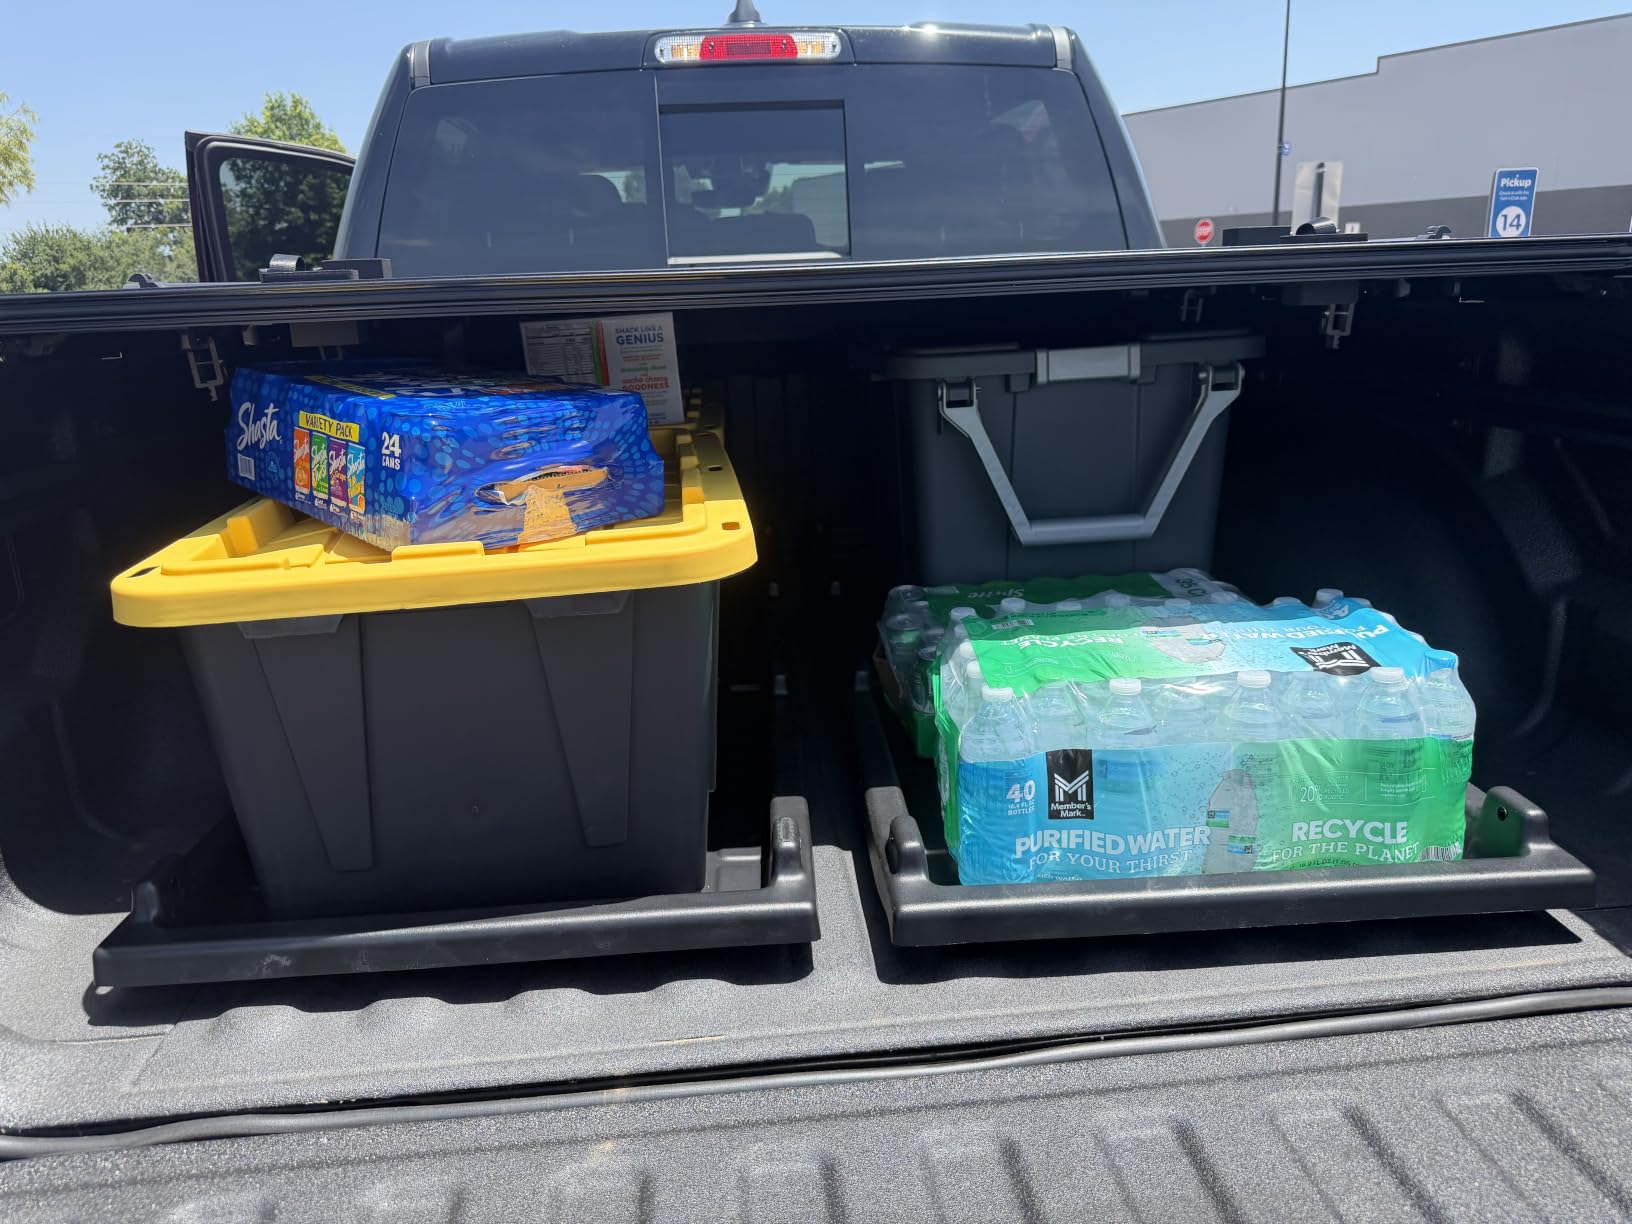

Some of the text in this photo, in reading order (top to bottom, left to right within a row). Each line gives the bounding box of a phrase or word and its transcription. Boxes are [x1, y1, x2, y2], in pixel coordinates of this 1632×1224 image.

[1501, 177, 1532, 188] Pickup
[1501, 214, 1521, 231] 14
[616, 332, 664, 345] GENIUS
[237, 401, 281, 450] Shasta
[305, 413, 353, 439] VARIETY PACK
[382, 431, 401, 457] 24
[382, 456, 400, 470] CANS
[1019, 635, 1124, 650] RECYCLE
[1006, 780, 1036, 803] 40
[1300, 784, 1323, 803] 20%
[1008, 807, 1035, 816] BOTTLES
[1051, 801, 1092, 811] Member's
[1060, 809, 1082, 818] Mark
[1292, 818, 1408, 844] RECYCLE
[1015, 826, 1211, 859] PURIFIED WATER
[1272, 844, 1303, 862] FOR
[1308, 841, 1349, 855] THE
[1355, 841, 1419, 863] PLANET
[1029, 850, 1193, 874] FOR YOUR THIRST
